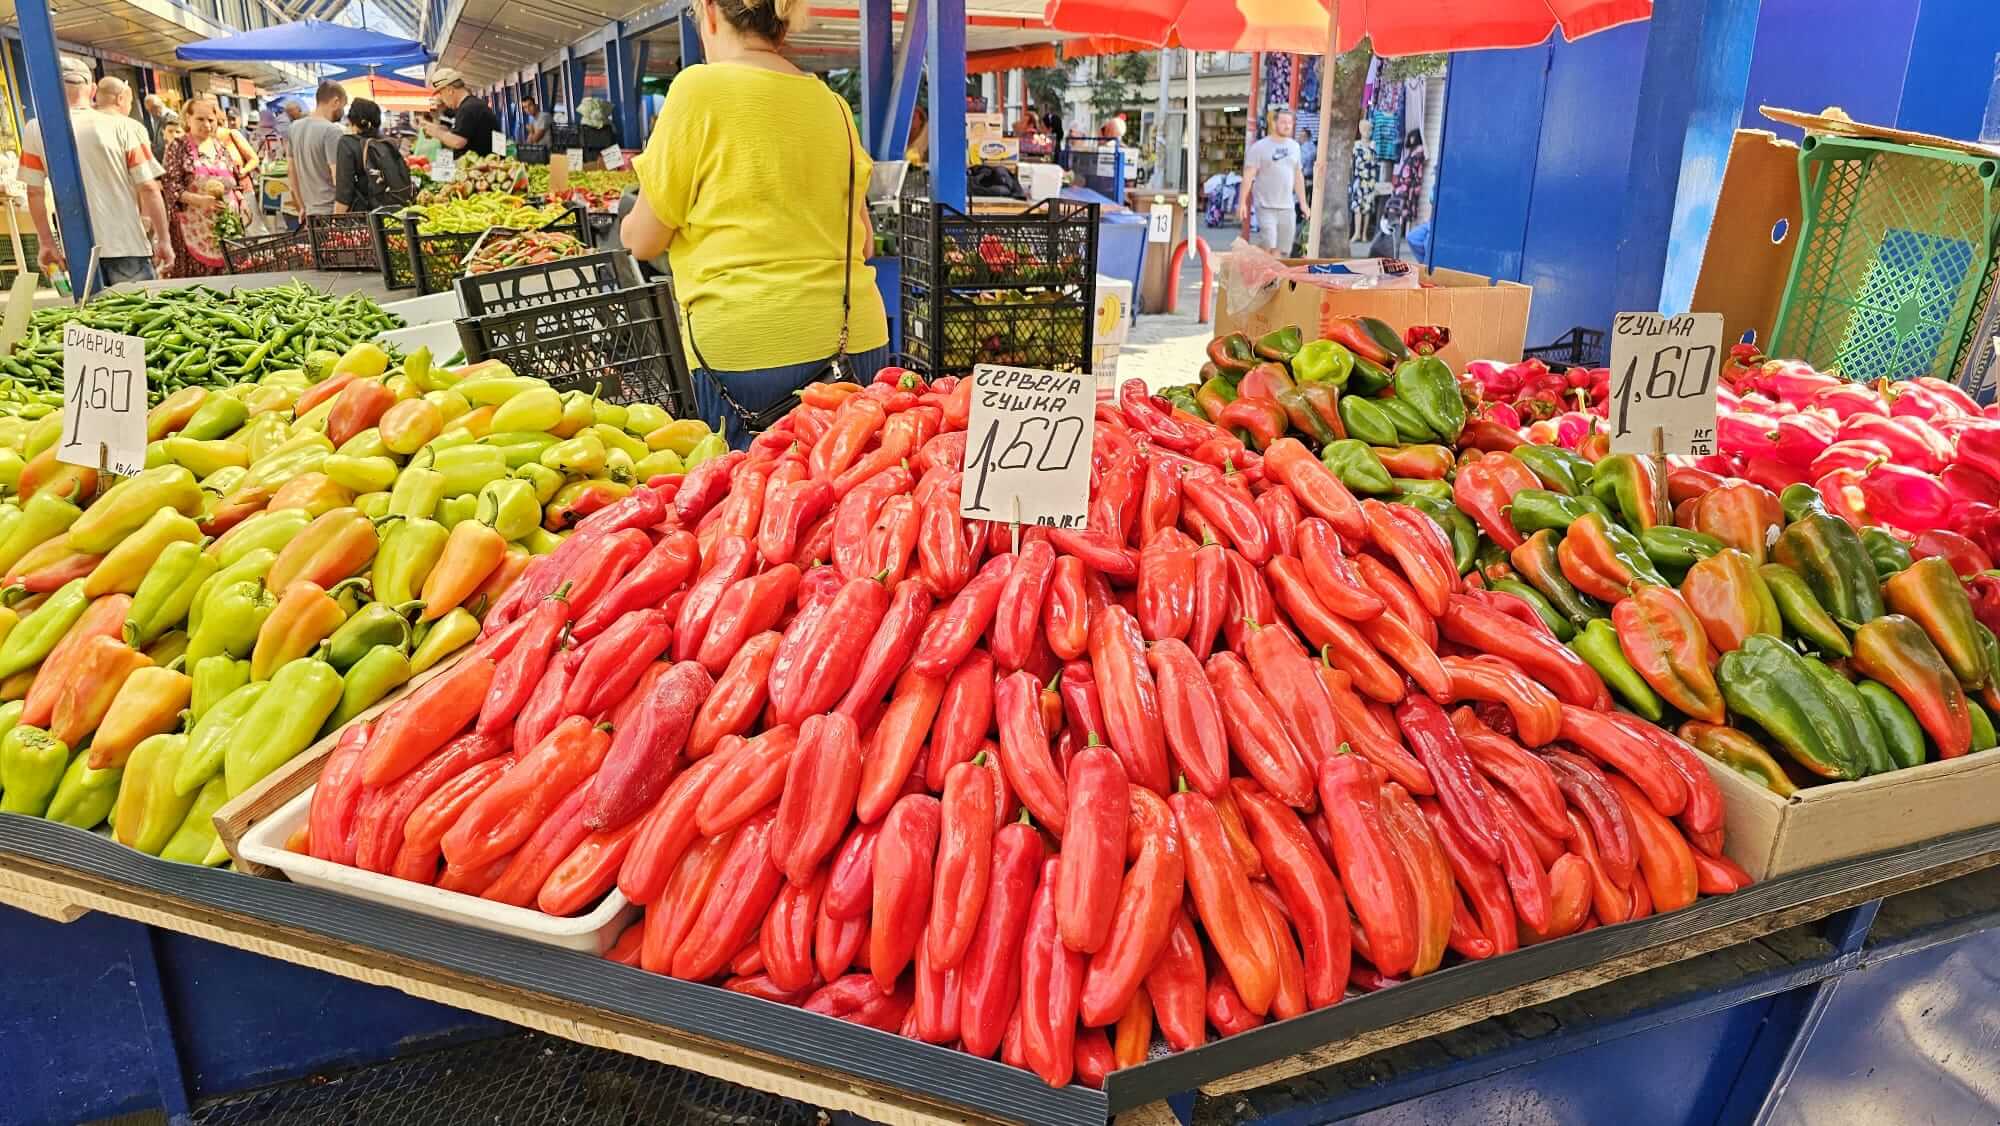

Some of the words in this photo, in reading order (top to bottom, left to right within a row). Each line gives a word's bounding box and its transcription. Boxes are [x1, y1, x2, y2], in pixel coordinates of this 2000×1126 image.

[1155, 214, 1168, 233] 13
[1617, 315, 1695, 337] ЧУШКА
[67, 328, 126, 359] СИВРИЯ
[976, 368, 1081, 394] ЧЕРВЕНА
[1613, 345, 1716, 439] 1,60
[982, 390, 1067, 413] ЧУШКА
[964, 416, 1084, 512] 1,60
